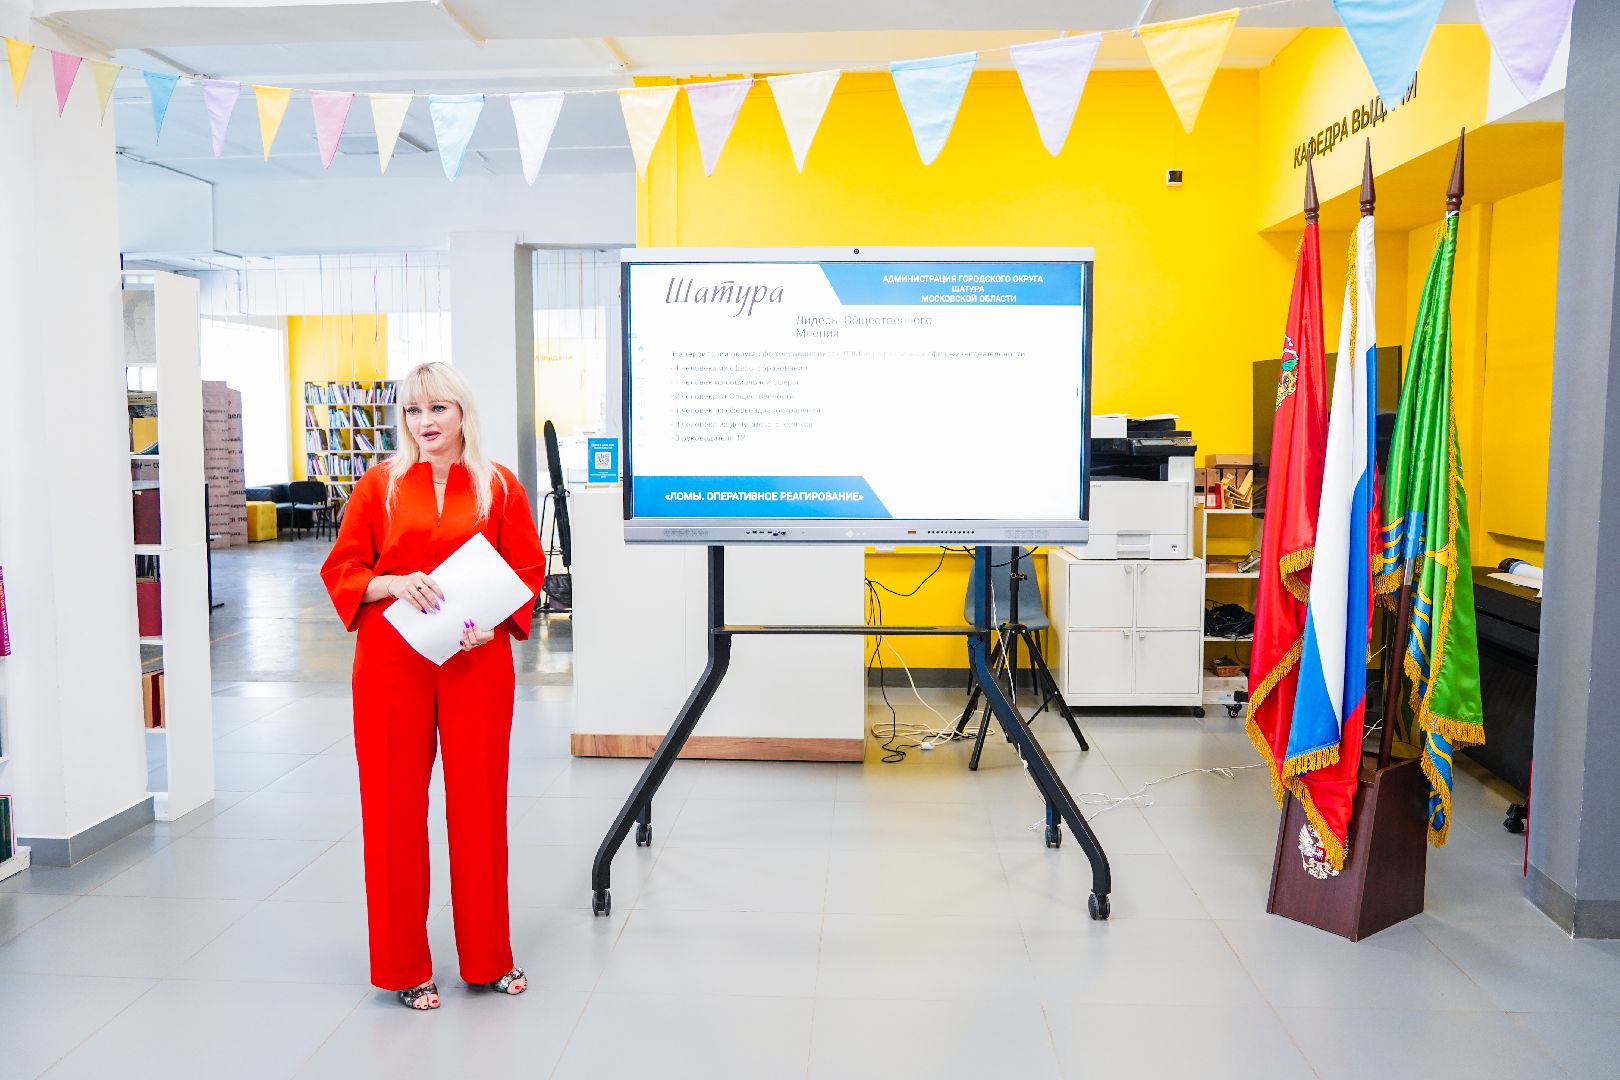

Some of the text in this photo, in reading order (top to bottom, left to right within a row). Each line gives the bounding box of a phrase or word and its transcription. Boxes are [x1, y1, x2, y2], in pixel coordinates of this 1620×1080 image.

[1293, 71, 1418, 169] КАФЕДРА ВЫДИ
[882, 274, 1044, 284] АДМИНИСТРАЦИЯ ГОРОДСКОГО ОКРУГА
[951, 285, 984, 293] ШАТУРА
[665, 277, 784, 318] Шатура
[921, 294, 1017, 303] МОСКОВСКОЙ ОБЛАСТИ
[665, 491, 864, 501] «ЛОМЫ. ОПЕРАТИВНОЕ РЕАГИРОВАНИЕ»
